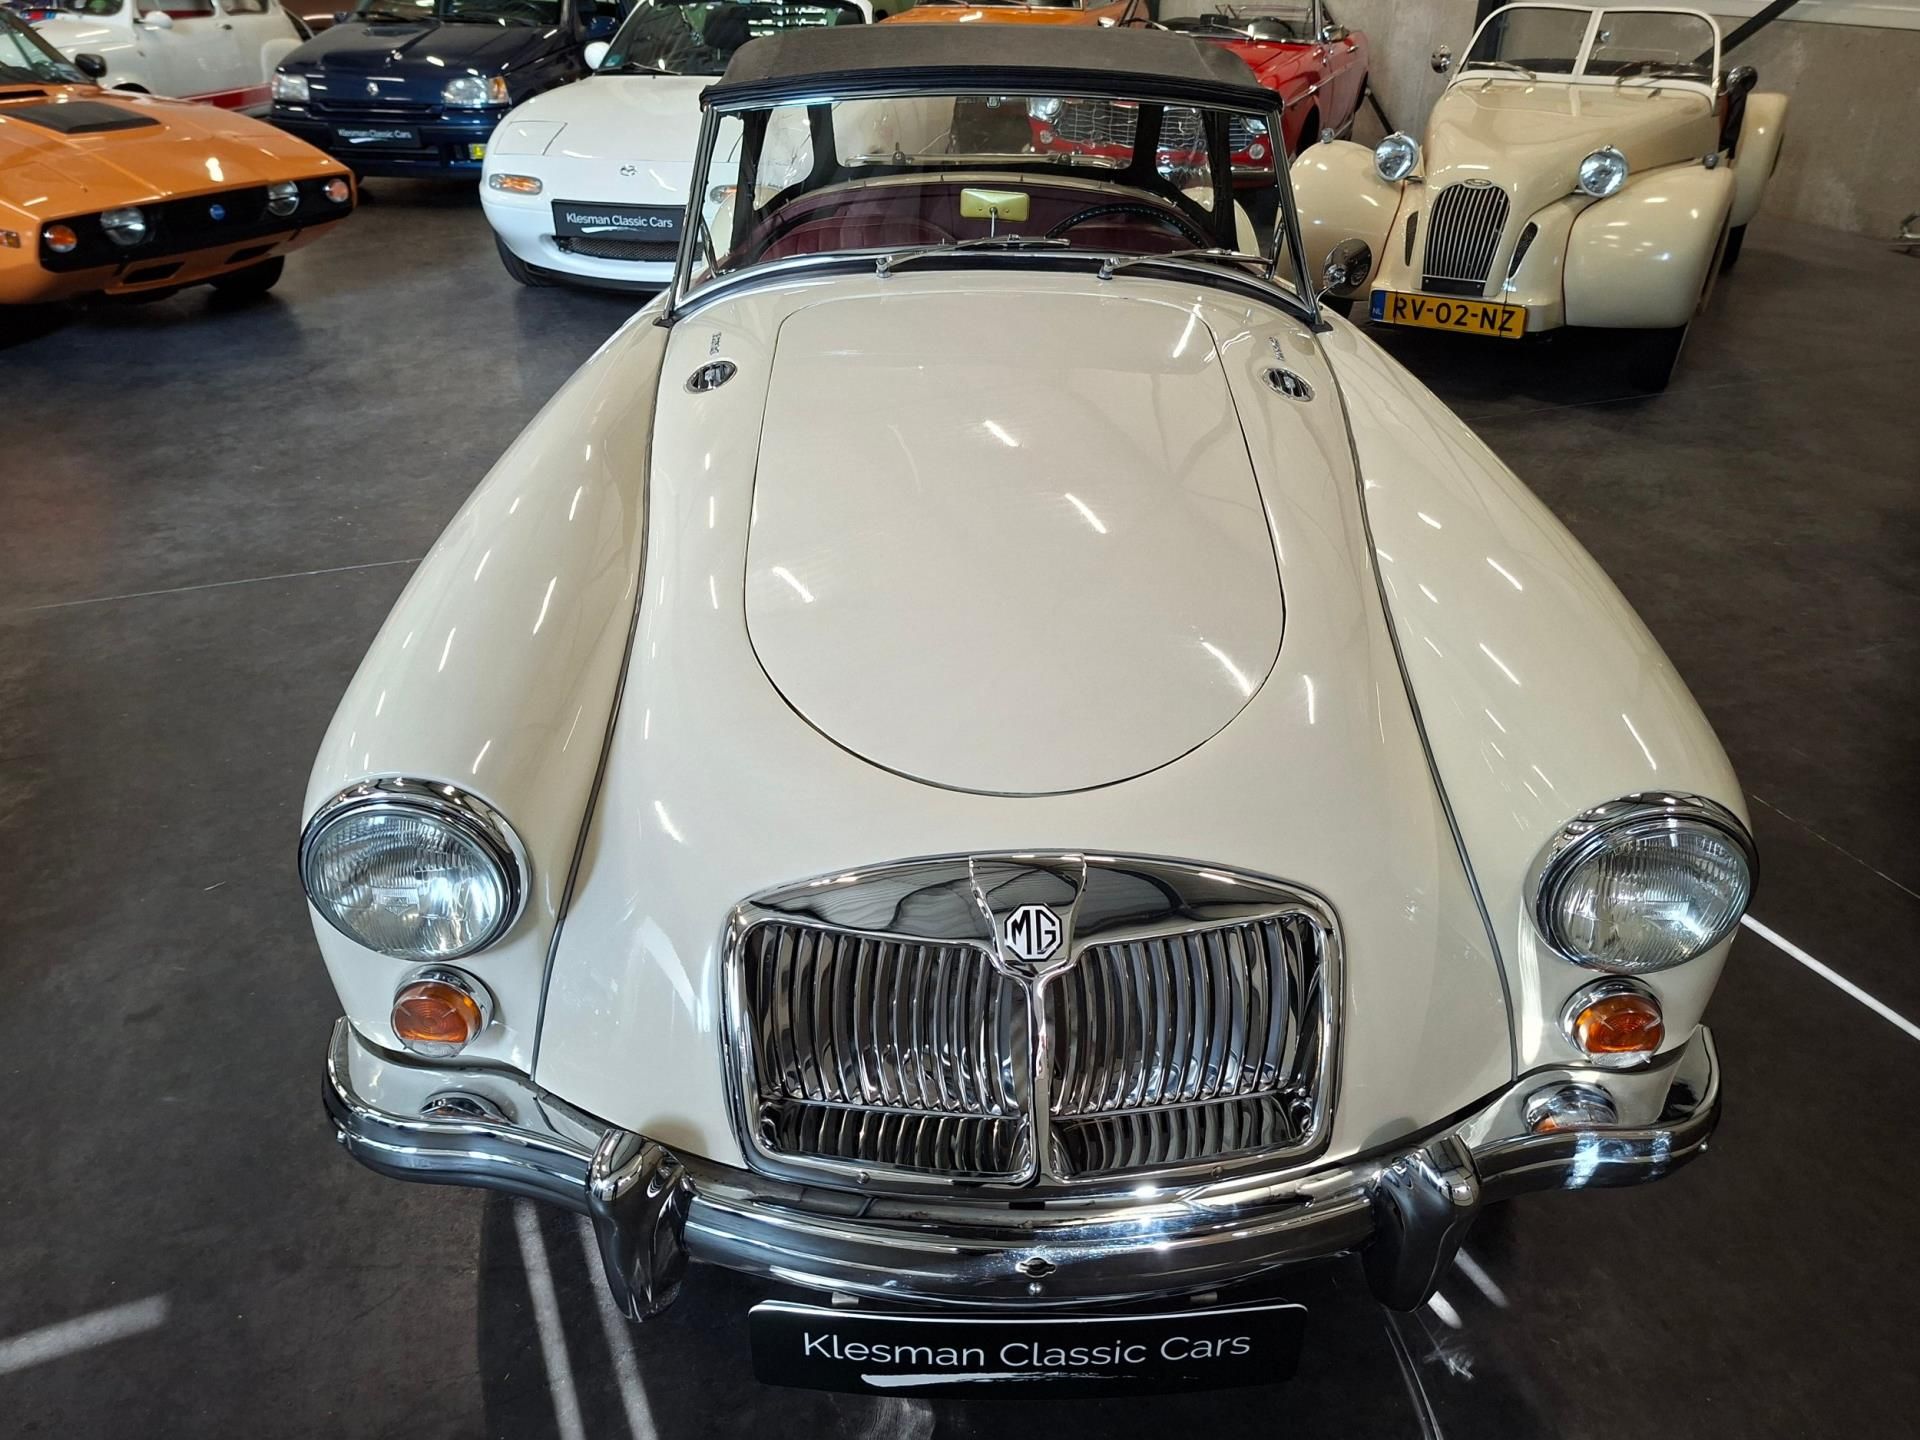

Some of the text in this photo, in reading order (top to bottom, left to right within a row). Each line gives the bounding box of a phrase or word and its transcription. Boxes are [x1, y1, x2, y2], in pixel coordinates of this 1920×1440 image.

[566, 212, 673, 228] Klesman Classic Cars
[1394, 296, 1515, 331] RV-02-NZ
[1010, 908, 1057, 956] MG
[803, 1332, 1251, 1367] Klesman Classic Cars
